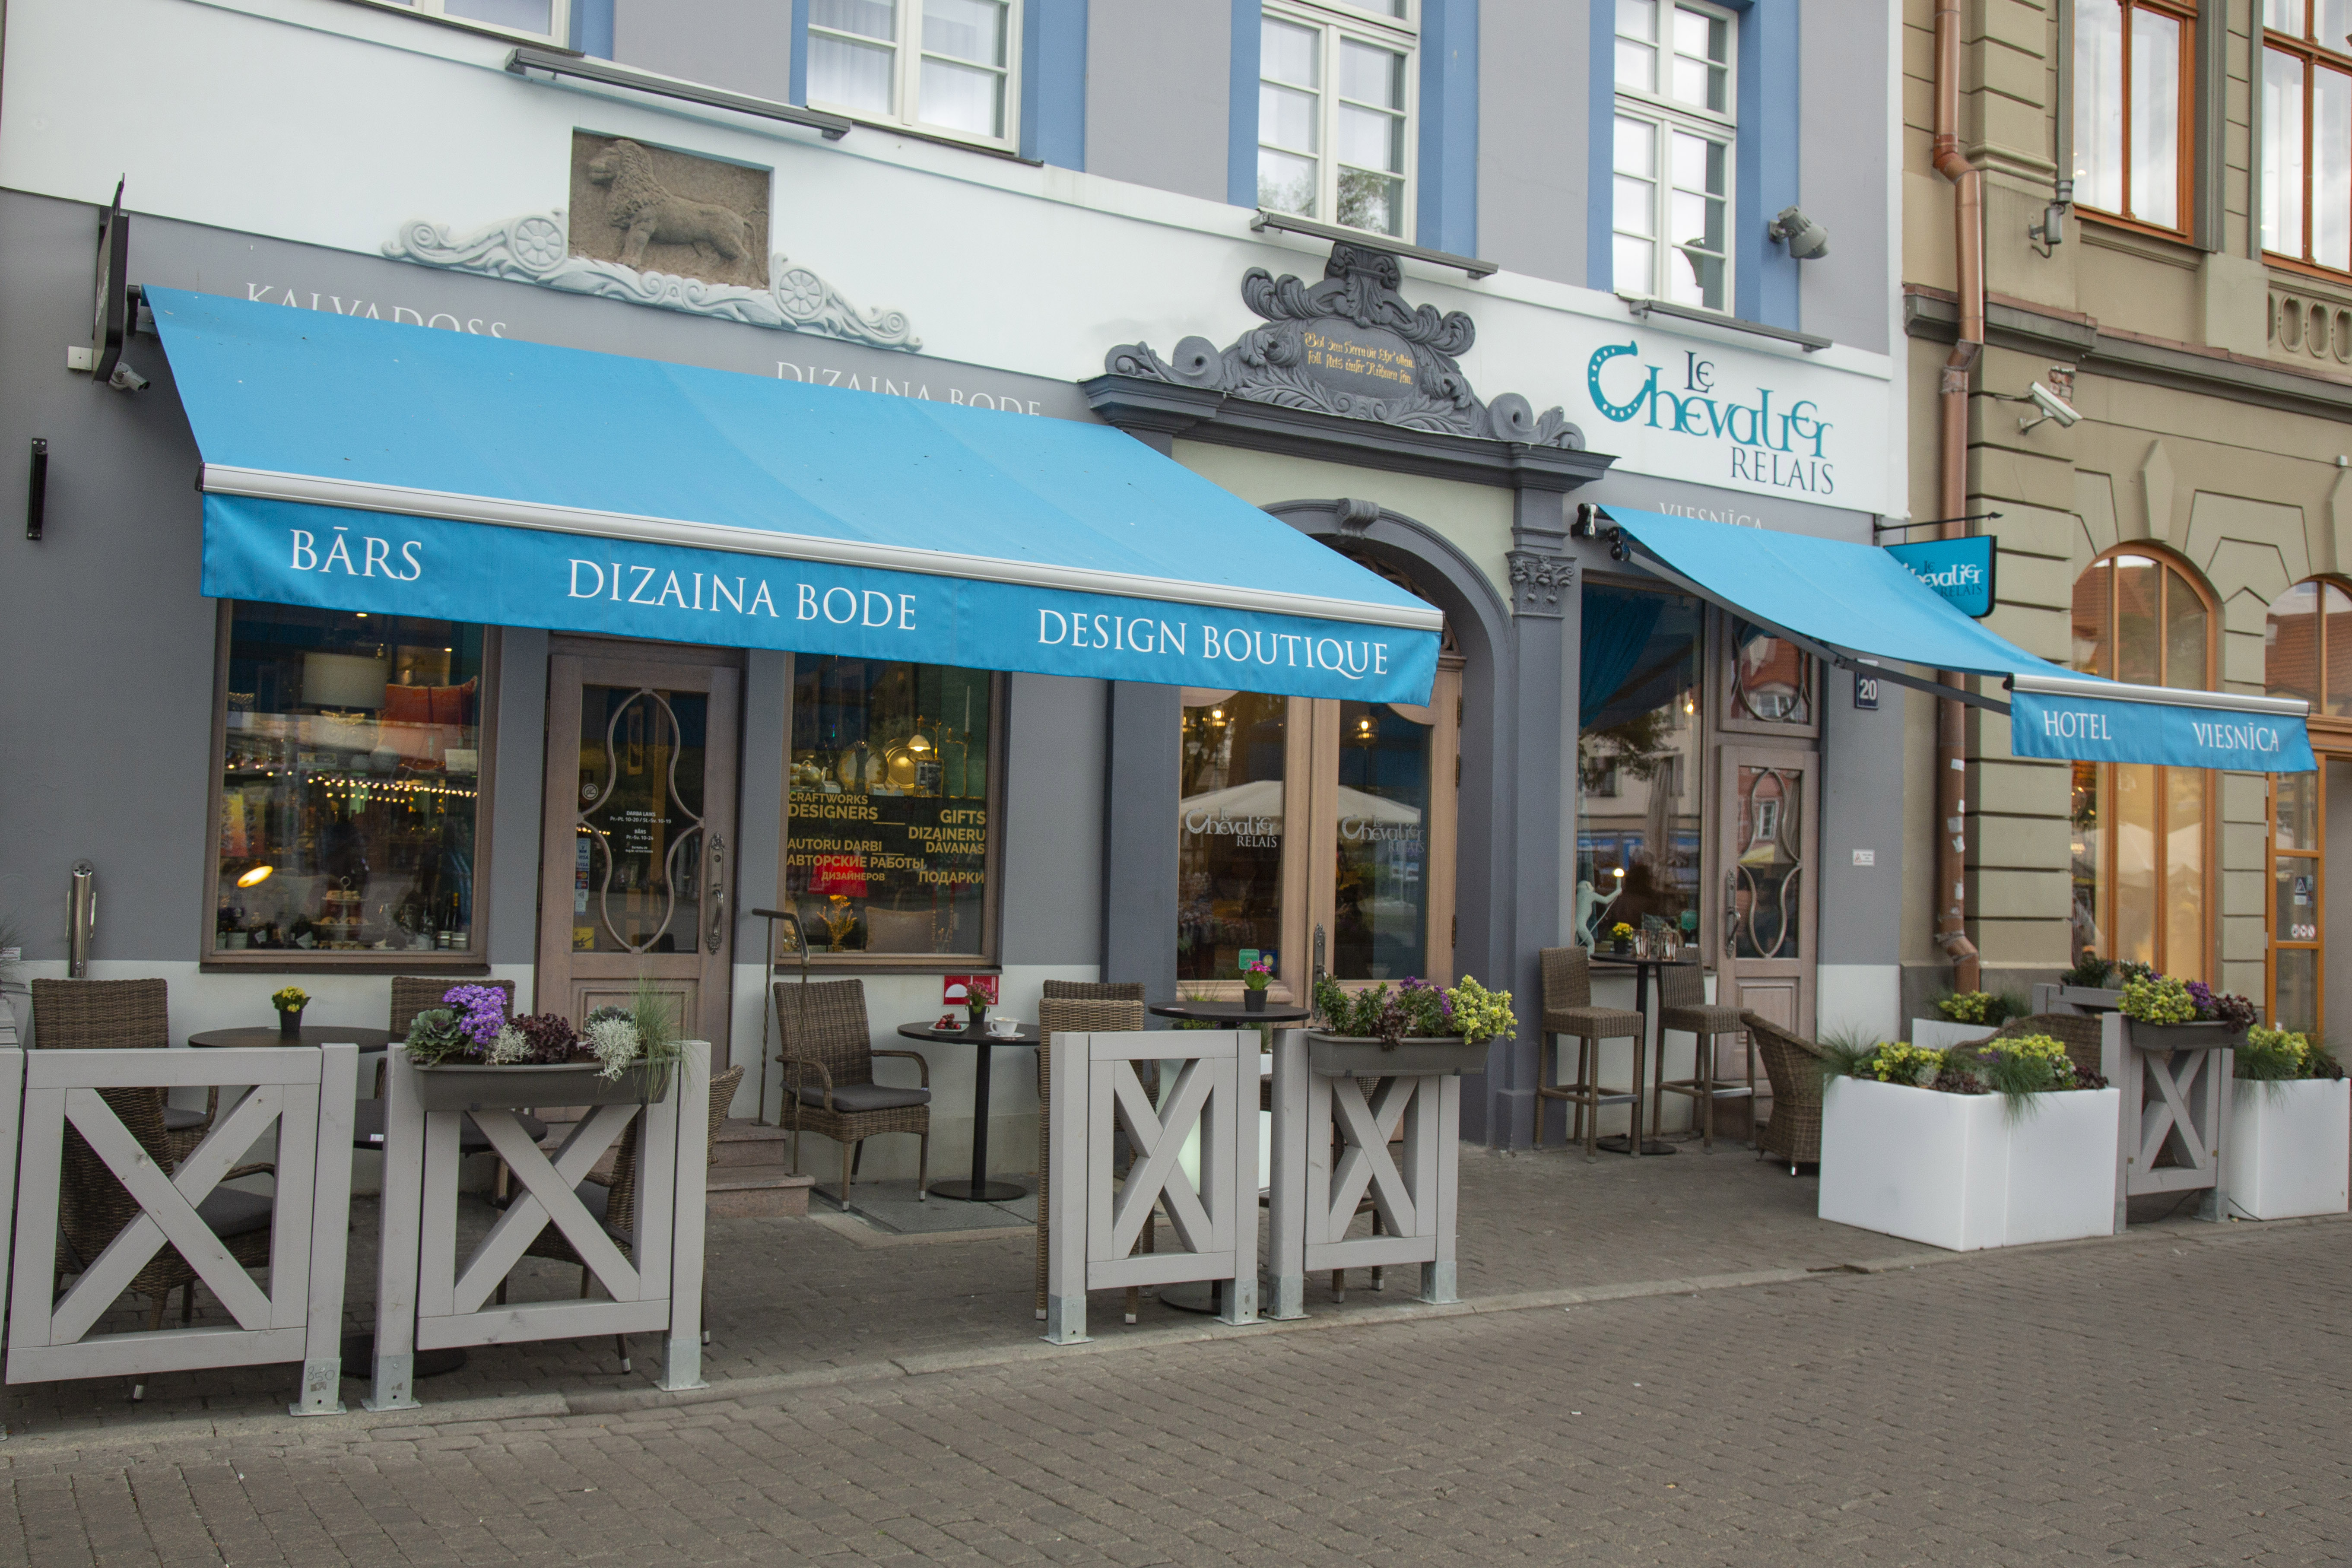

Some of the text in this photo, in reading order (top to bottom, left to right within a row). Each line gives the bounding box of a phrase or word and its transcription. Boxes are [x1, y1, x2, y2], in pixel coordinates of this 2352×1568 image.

[1588, 340, 1834, 459] Chevalier
[1730, 446, 1834, 495] RELAIS
[290, 526, 422, 581] BĀRS
[568, 559, 916, 630] DIZAINA BODE
[1940, 584, 1983, 597] RELAIS
[1038, 609, 1387, 679] DESIGN BOUTIQUE
[1860, 679, 1877, 700] 20
[2043, 711, 2111, 740] HOTEL
[2192, 723, 2279, 752] VIESNĪCA
[789, 792, 868, 805] CRAFTWORKS
[788, 804, 878, 820] DESIGNERS
[940, 809, 986, 825] GIFTS
[1186, 808, 1277, 836] Chevalier
[909, 827, 986, 841] DIZAINERU
[1237, 835, 1277, 847] RELAIS
[787, 838, 882, 852] AUTORU DARBI
[1388, 841, 1424, 853] RELAIS
[787, 855, 924, 869] АВТОРСКИЕ РАБОТЫ
[821, 871, 885, 881] ДИЗАЙНЕРОВ
[919, 871, 985, 885] ПОДАРКИ
[307, 1366, 335, 1381] 850
